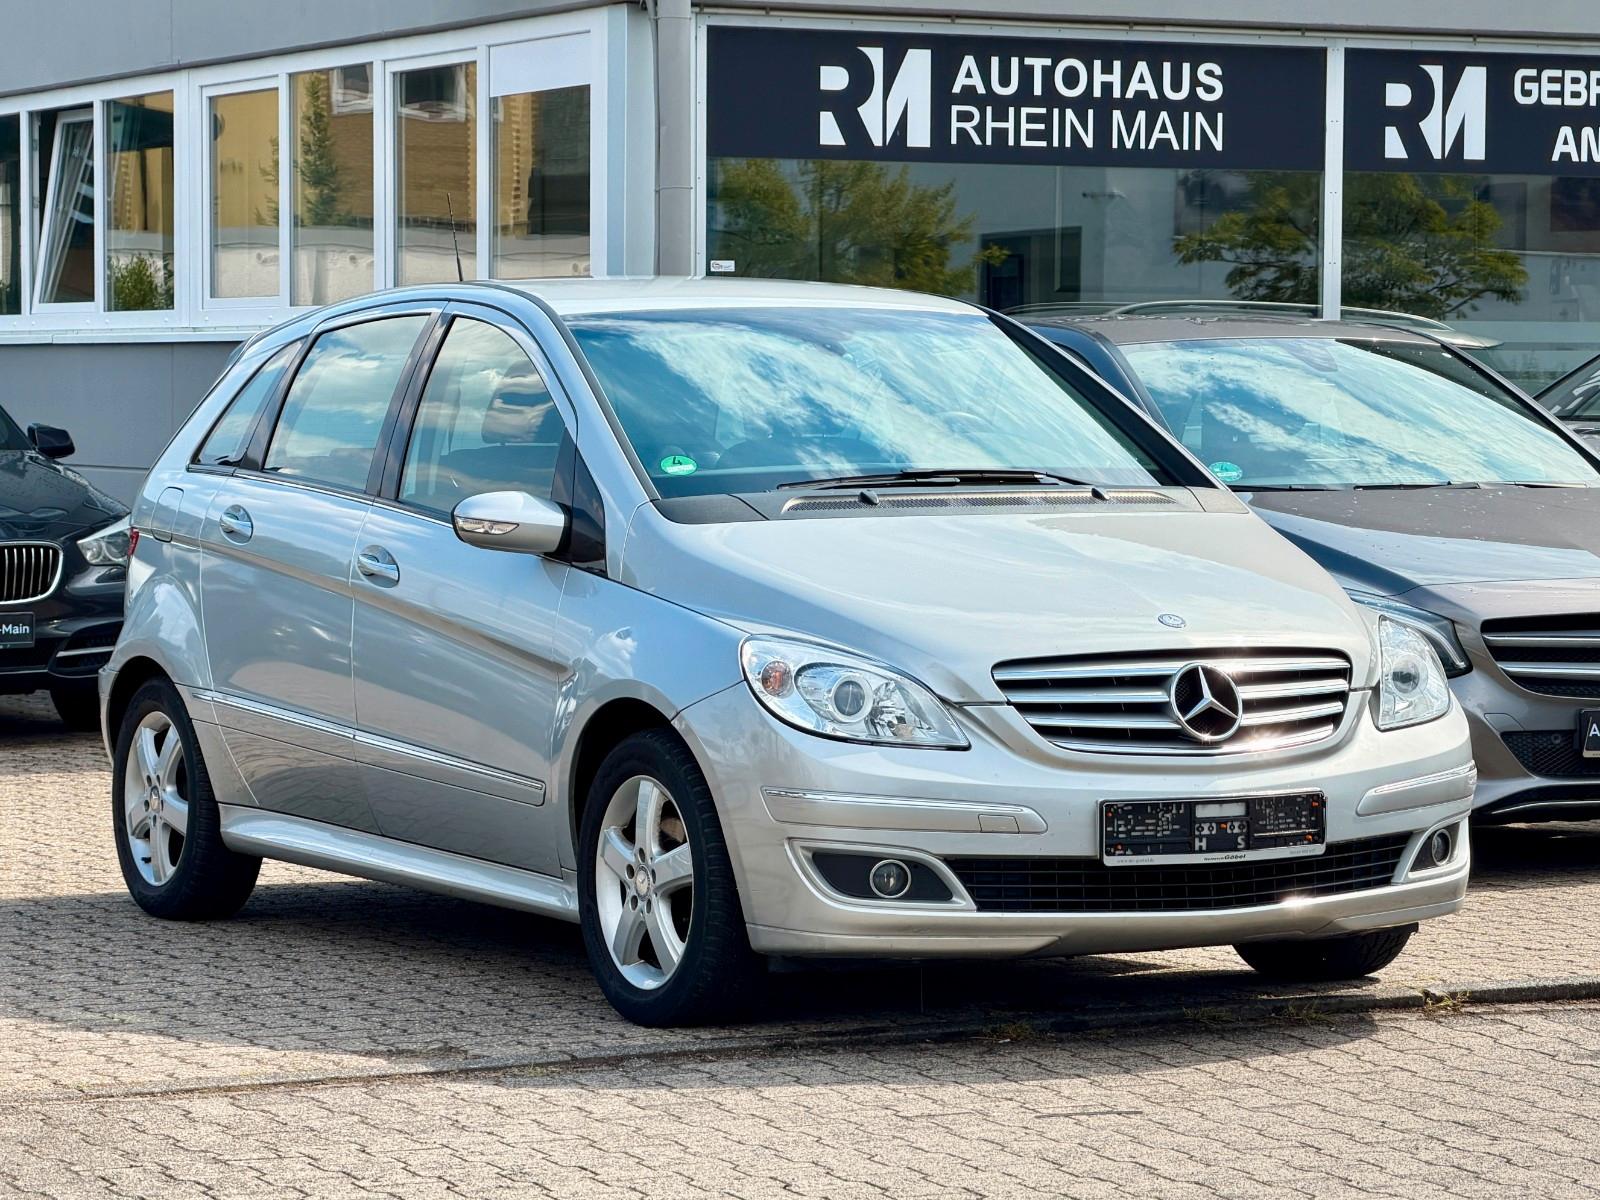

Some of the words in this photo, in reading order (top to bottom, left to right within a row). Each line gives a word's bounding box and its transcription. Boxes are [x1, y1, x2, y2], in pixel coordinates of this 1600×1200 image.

[951, 54, 1224, 102] AUTOHAUS
[950, 104, 1094, 149] RHEIN
[1111, 109, 1223, 152] MAIN
